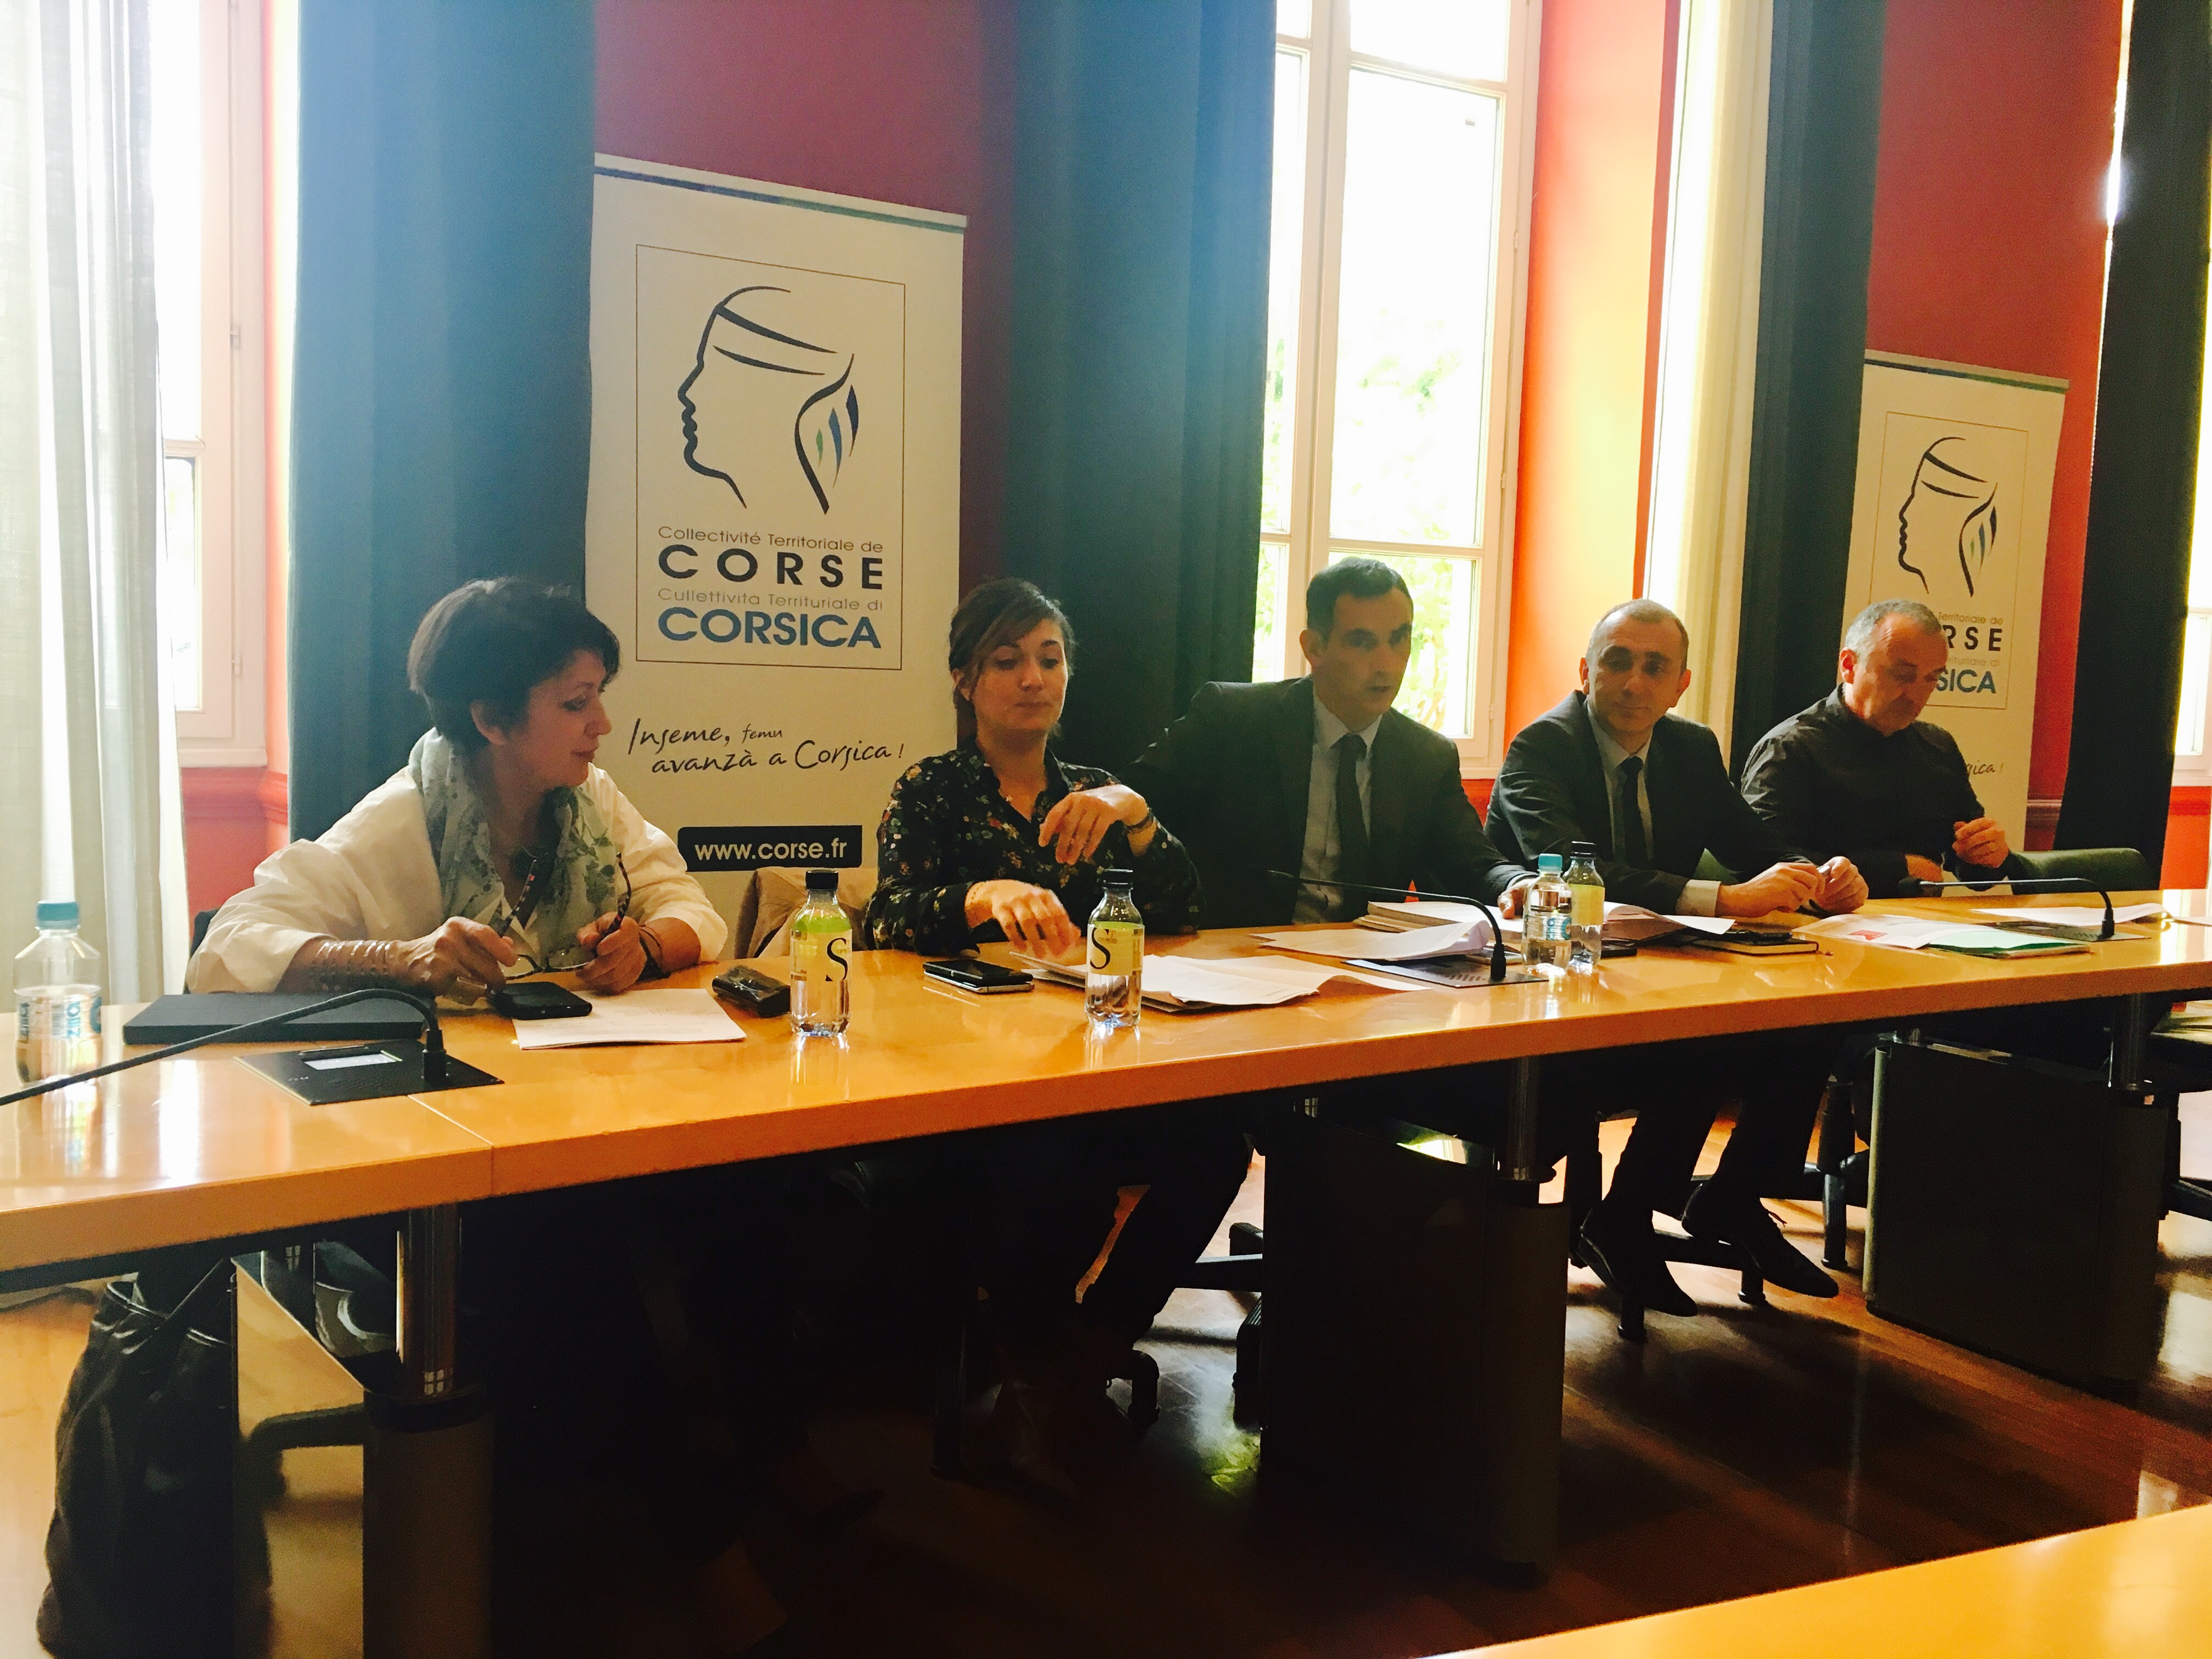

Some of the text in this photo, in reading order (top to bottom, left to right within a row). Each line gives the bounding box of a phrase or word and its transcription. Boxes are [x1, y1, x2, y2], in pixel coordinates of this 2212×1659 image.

[658, 526, 883, 553] Collectivité Territoriale de
[658, 544, 882, 590] CORSE
[768, 594, 860, 611] Territuriale
[867, 600, 883, 611] di
[658, 607, 882, 648] CORSICA
[1943, 624, 2002, 652] RSE
[1936, 668, 1997, 694] SICA
[628, 718, 730, 755] Inseme,
[652, 749, 758, 773] avanzà
[769, 752, 787, 766] a
[694, 837, 848, 860] www.corse.fr
